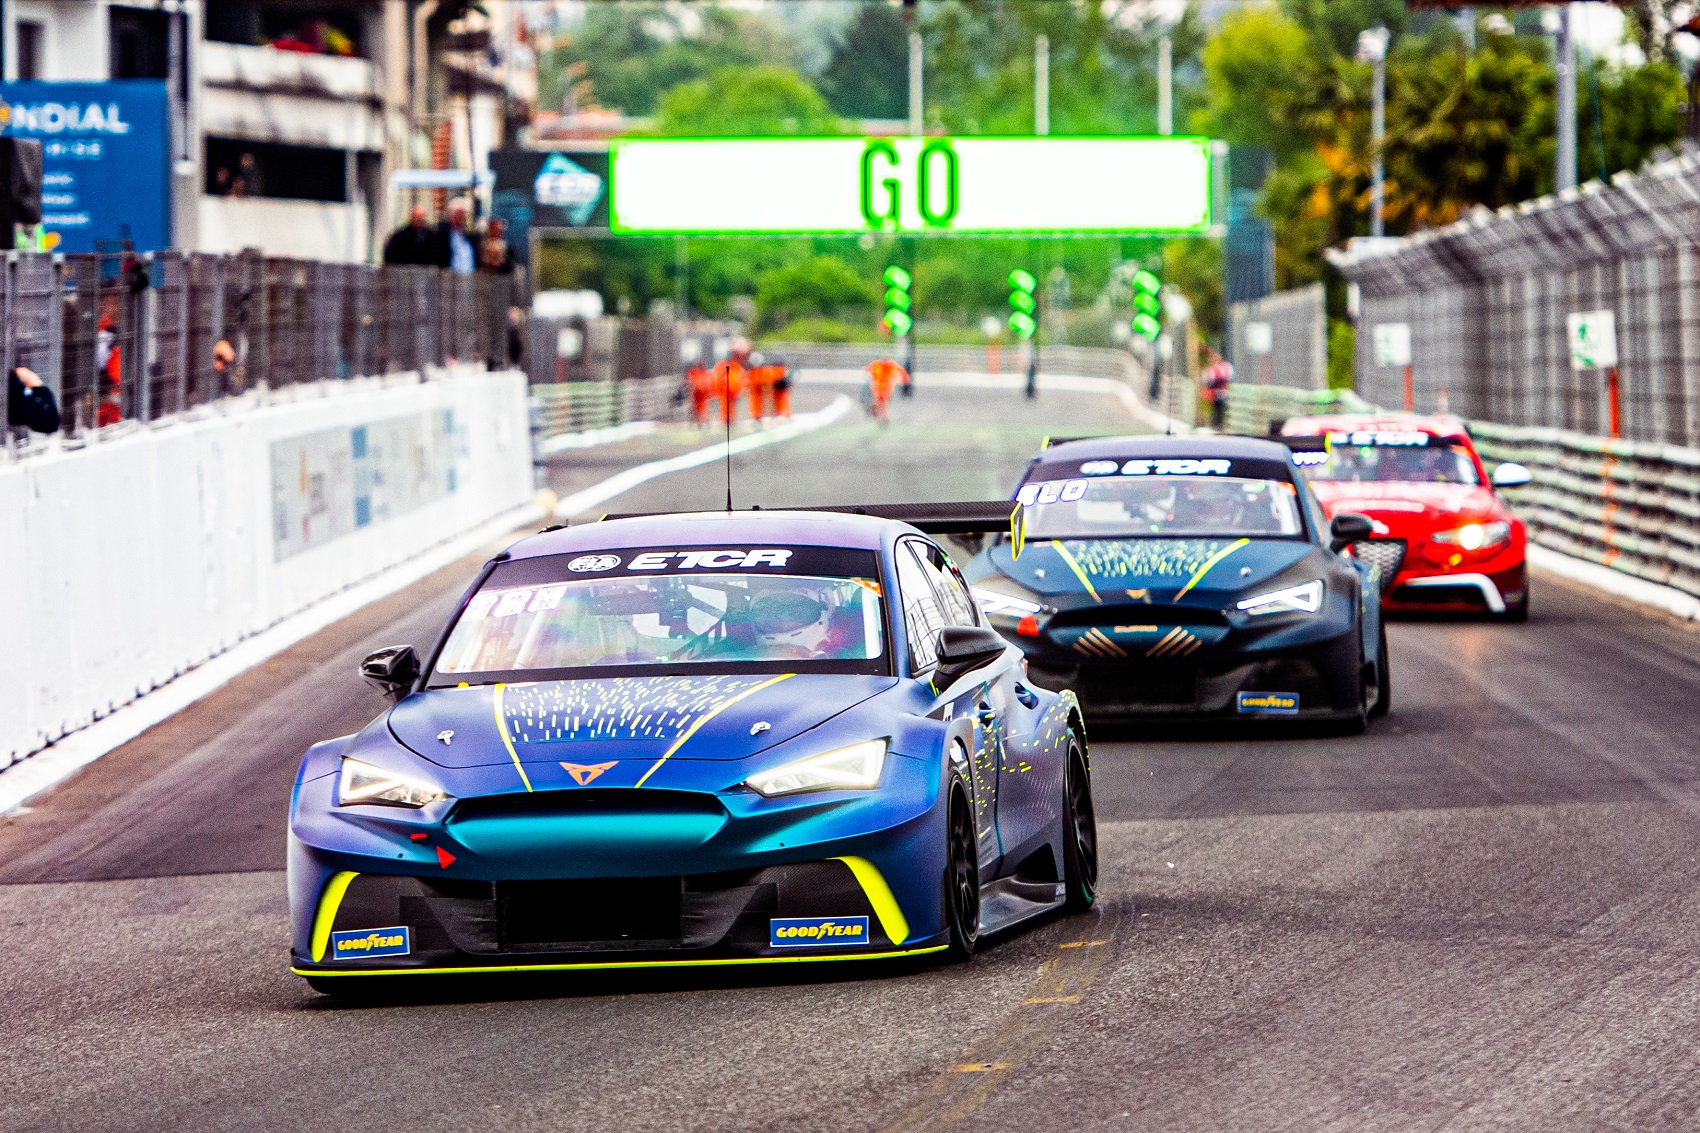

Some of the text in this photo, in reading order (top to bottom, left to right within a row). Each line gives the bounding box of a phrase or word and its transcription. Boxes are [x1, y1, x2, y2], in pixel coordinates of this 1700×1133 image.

[860, 142, 958, 227] GO
[627, 549, 793, 570] ETCR
[777, 922, 863, 940] GOODYEAR
[337, 933, 404, 951] GOODYEAR
